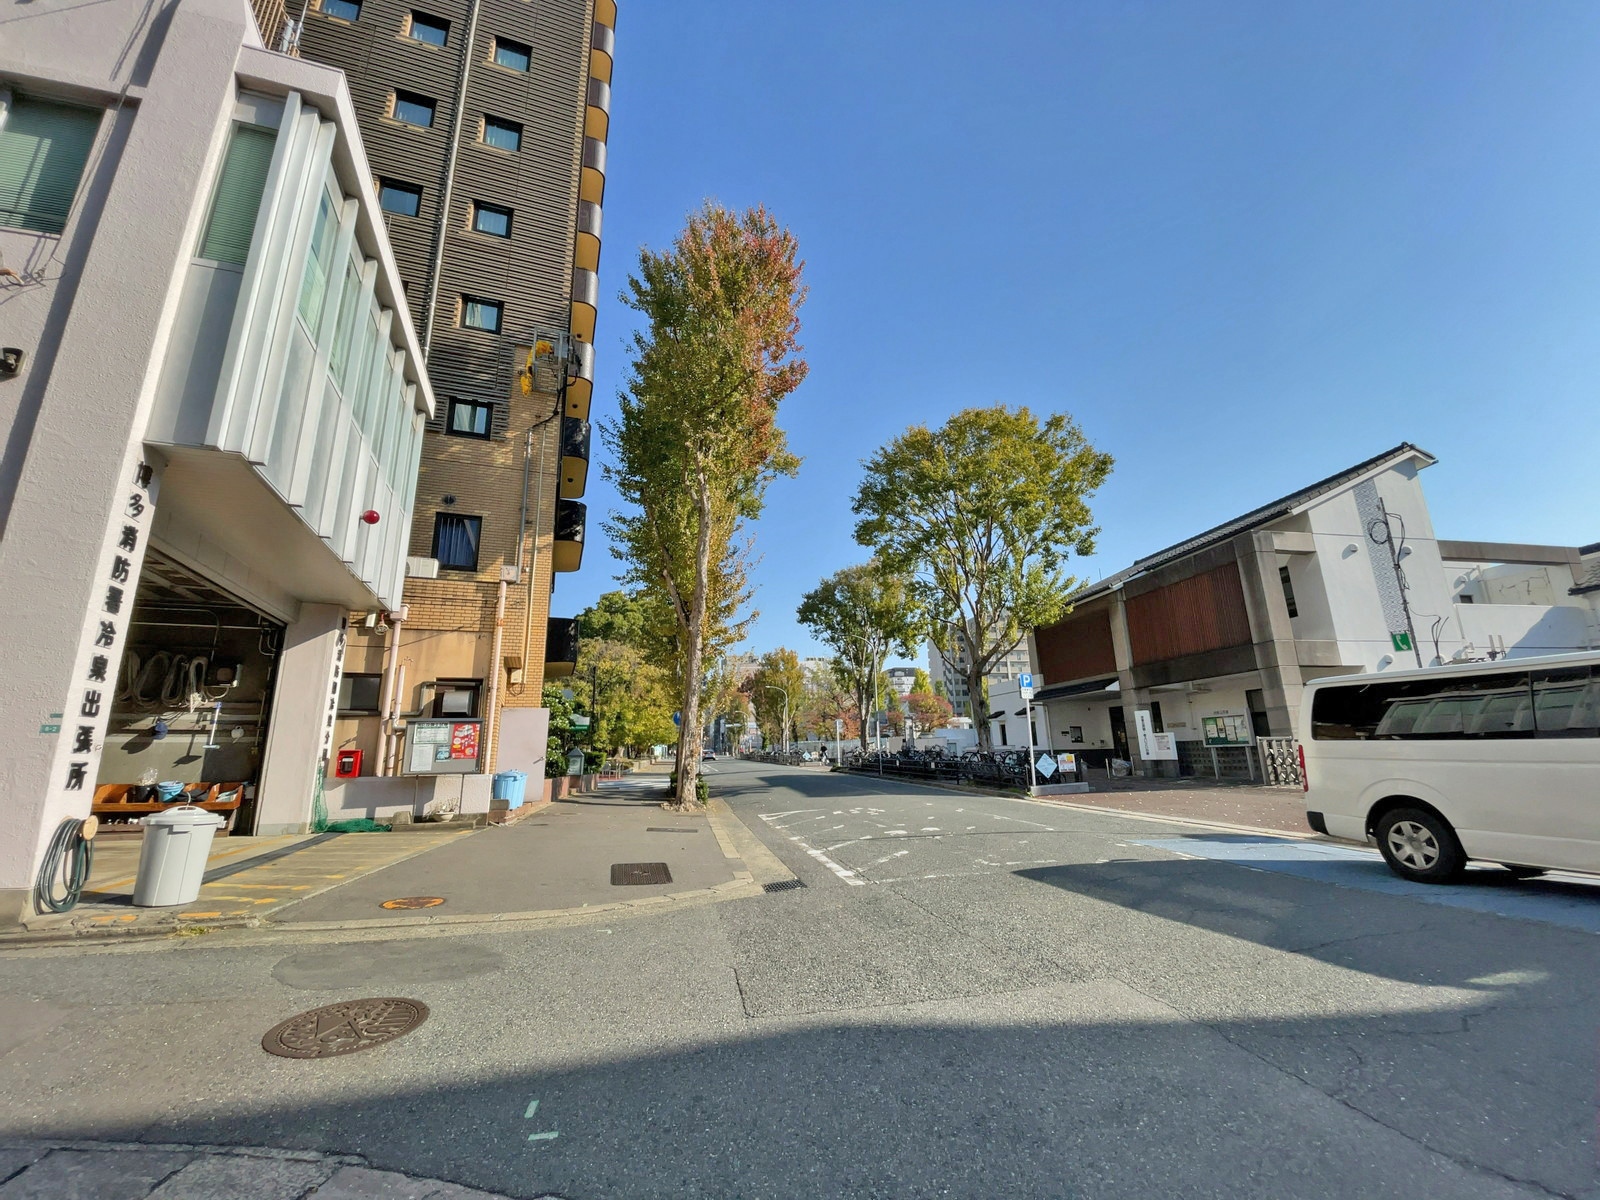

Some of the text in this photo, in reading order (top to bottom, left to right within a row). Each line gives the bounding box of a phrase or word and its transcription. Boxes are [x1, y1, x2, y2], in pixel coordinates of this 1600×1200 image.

[64, 461, 154, 791] 博多消防署冷泉出張所
[1023, 675, 1031, 686] P
